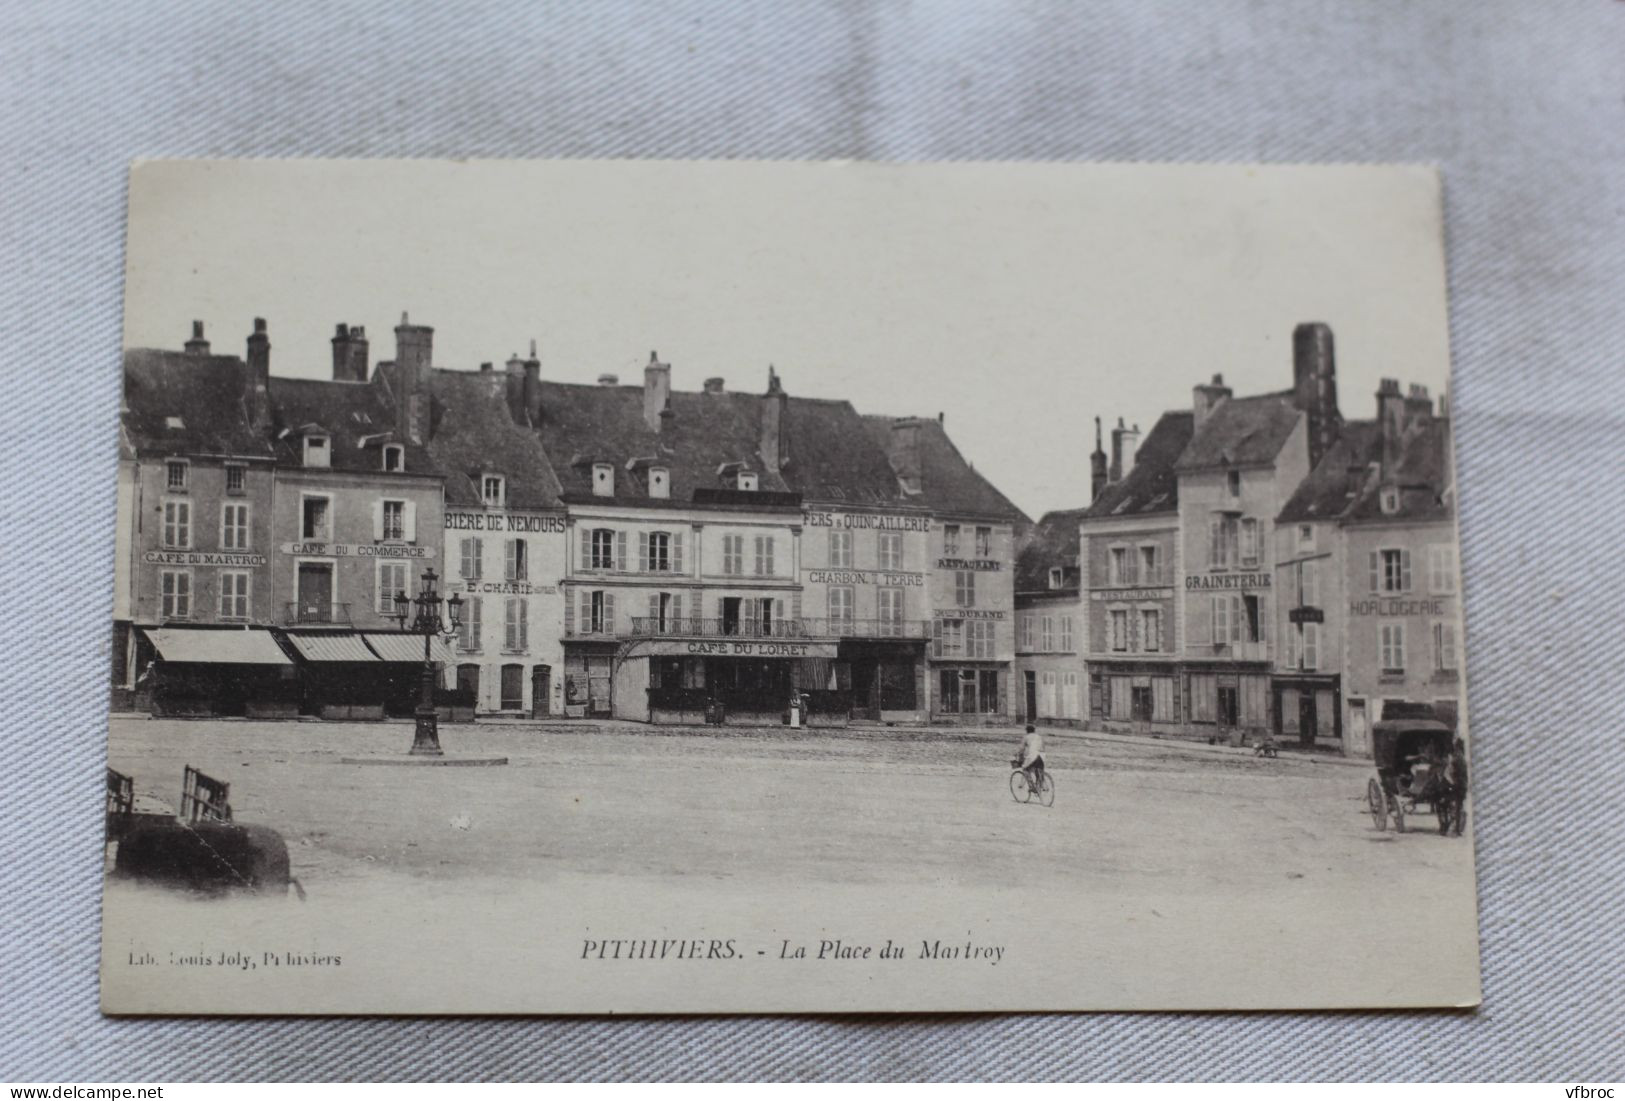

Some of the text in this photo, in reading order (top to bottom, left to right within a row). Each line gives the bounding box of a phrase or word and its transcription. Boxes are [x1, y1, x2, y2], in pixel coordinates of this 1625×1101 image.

[486, 513, 504, 531] DE
[507, 515, 566, 533] NEMOURS
[803, 511, 833, 527] FERS
[843, 514, 930, 533] QUINCAILLERIE
[188, 554, 202, 564] DU
[335, 545, 349, 556] DU
[357, 545, 426, 558] COMMERCE
[938, 558, 1001, 571] RESTAURANT
[884, 573, 924, 587] TERRE
[1185, 573, 1271, 591] GRAINETERIE
[958, 610, 1004, 620] DURAND
[1350, 600, 1444, 617] HORLOGERIE
[733, 643, 753, 655] DU
[758, 644, 808, 657] LOIRET
[580, 939, 744, 960] PITHIVIERS.
[778, 939, 807, 960] La
[816, 938, 872, 960] Place
[879, 939, 905, 960] du
[919, 938, 1006, 966] Martroy
[217, 951, 257, 970] Joly,
